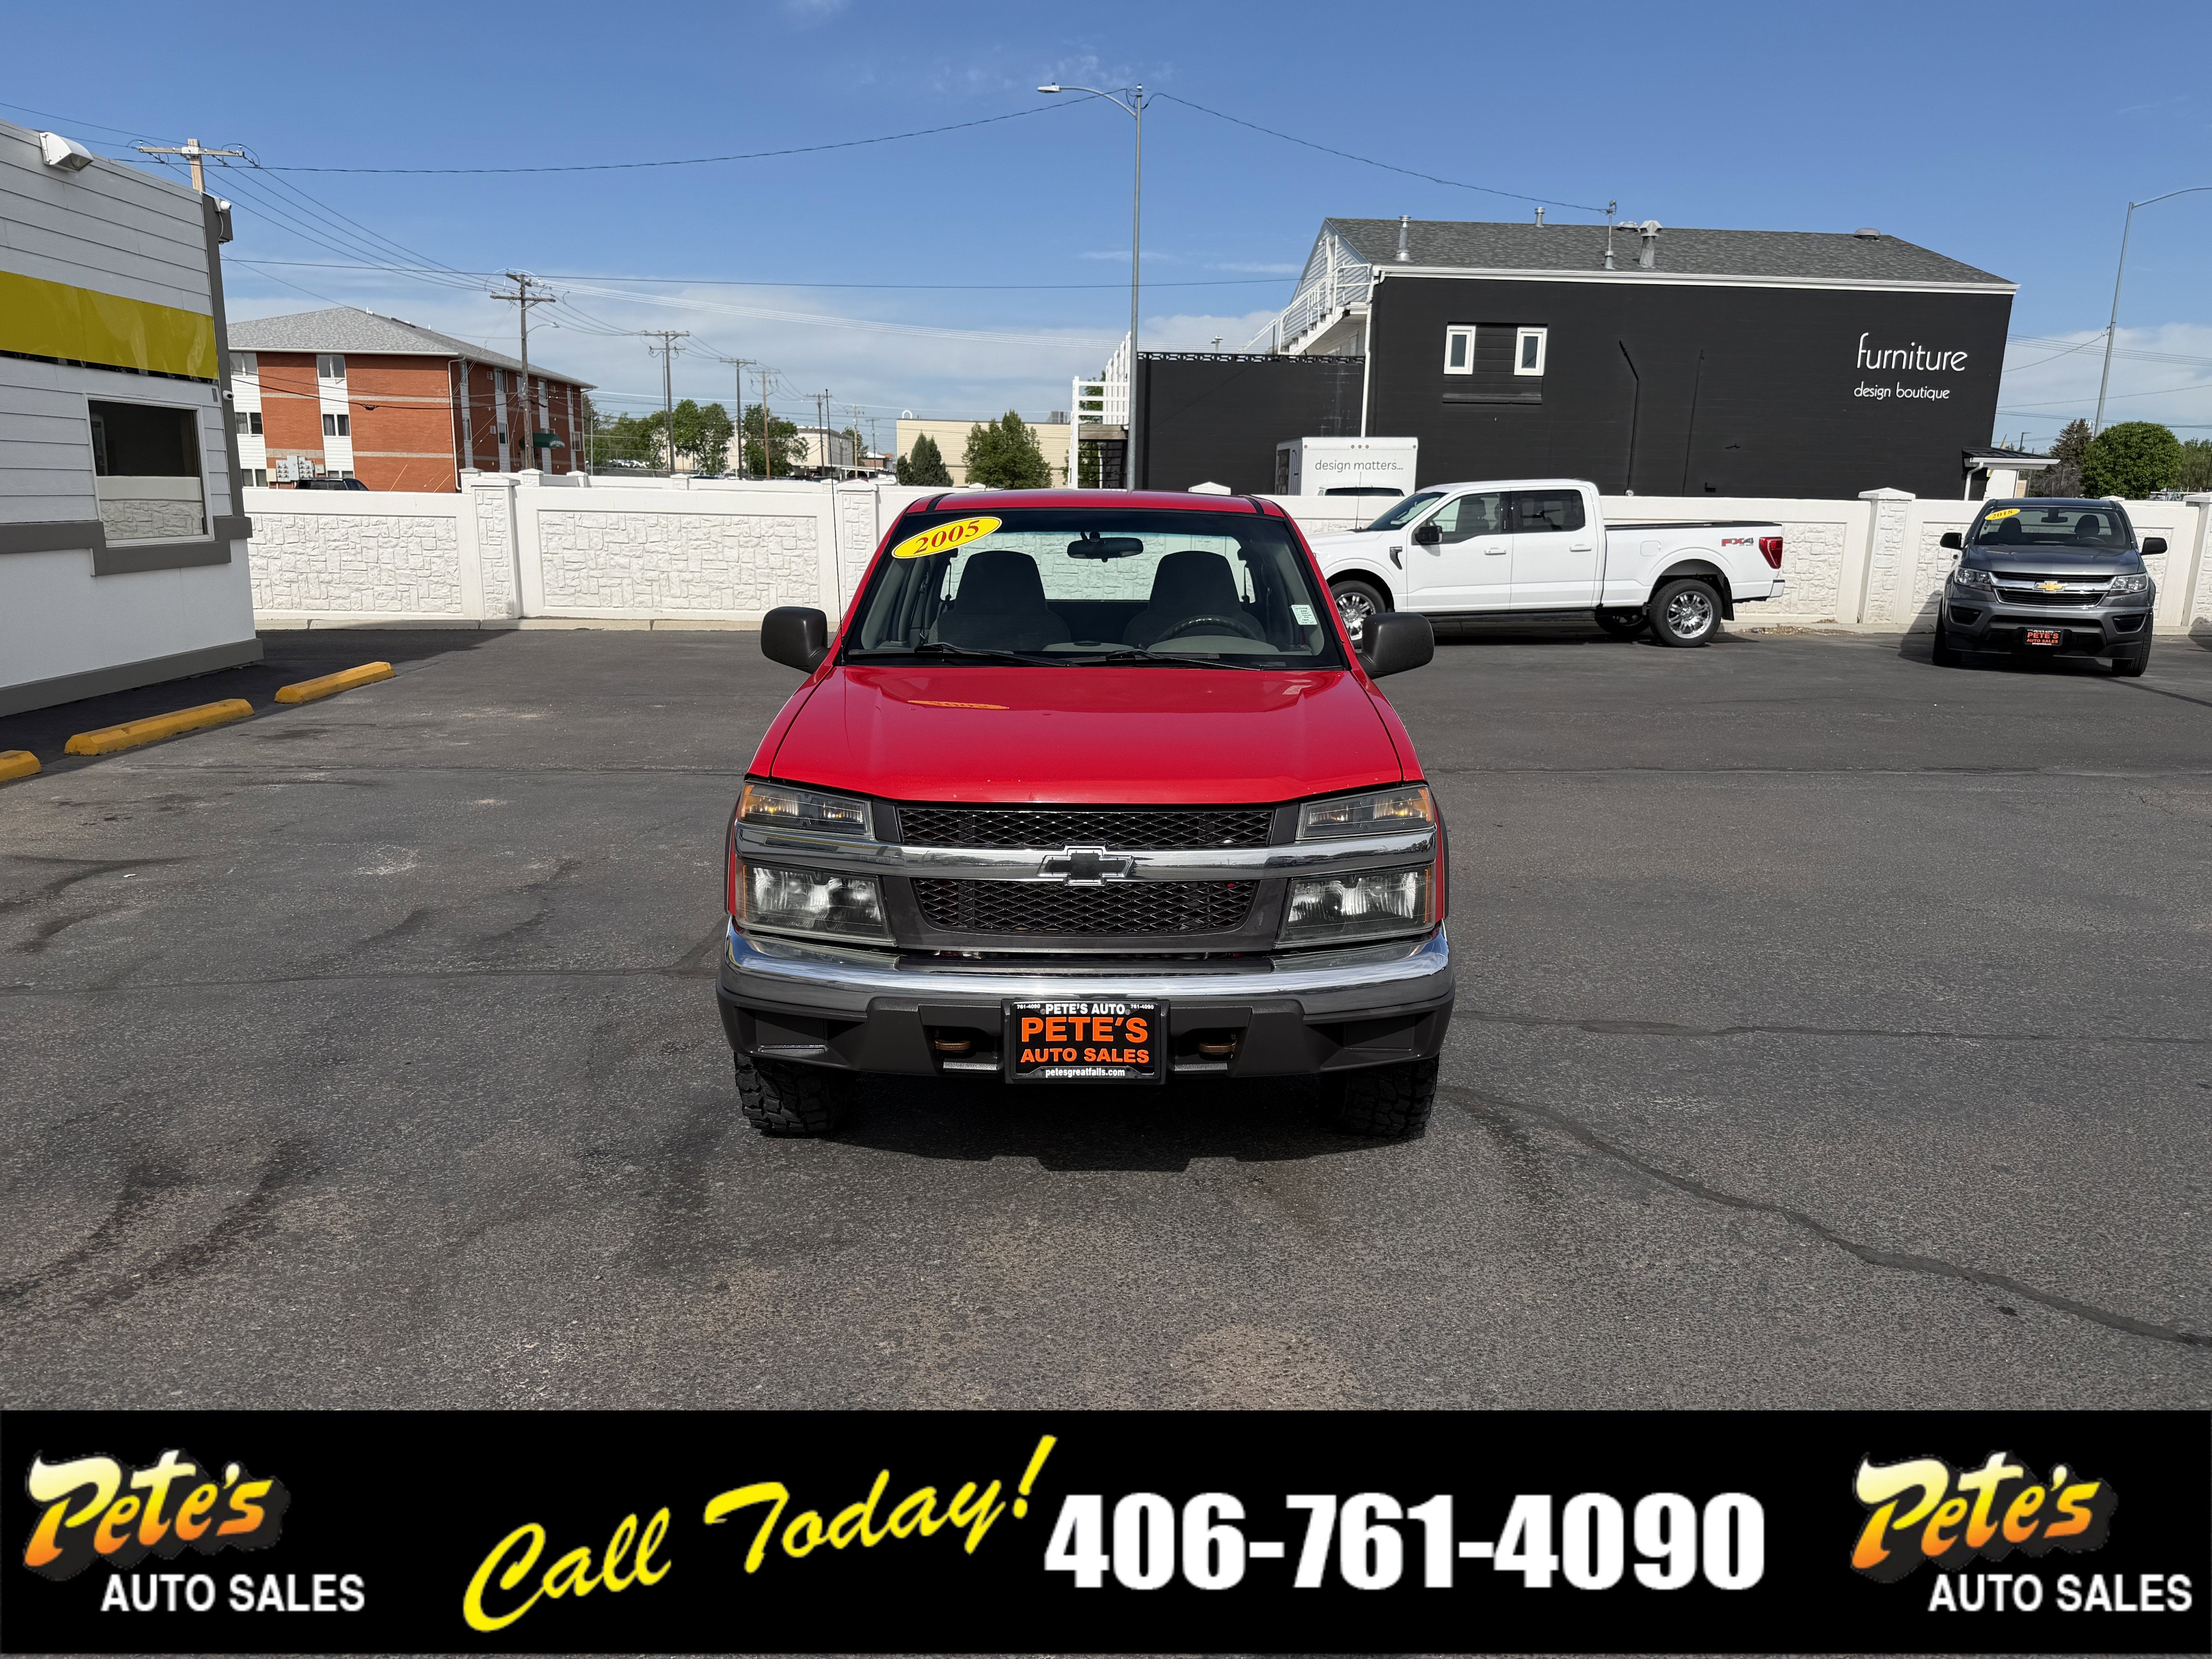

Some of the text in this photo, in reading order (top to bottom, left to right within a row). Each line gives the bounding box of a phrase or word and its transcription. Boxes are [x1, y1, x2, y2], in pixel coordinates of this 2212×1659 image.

[1857, 332, 1968, 371] furniture
[1854, 381, 1950, 401] design boutique
[1315, 459, 1403, 473] design matters...
[1992, 510, 2013, 519] 2018
[913, 520, 980, 555] 2005
[1721, 538, 1754, 546] FX4
[1046, 1004, 1125, 1015] PETE'S AUTO
[1022, 1017, 1148, 1043] PETE'S
[1021, 1048, 1149, 1063] AUTO SALES
[1046, 1068, 1125, 1078] petesgreatfalls.com
